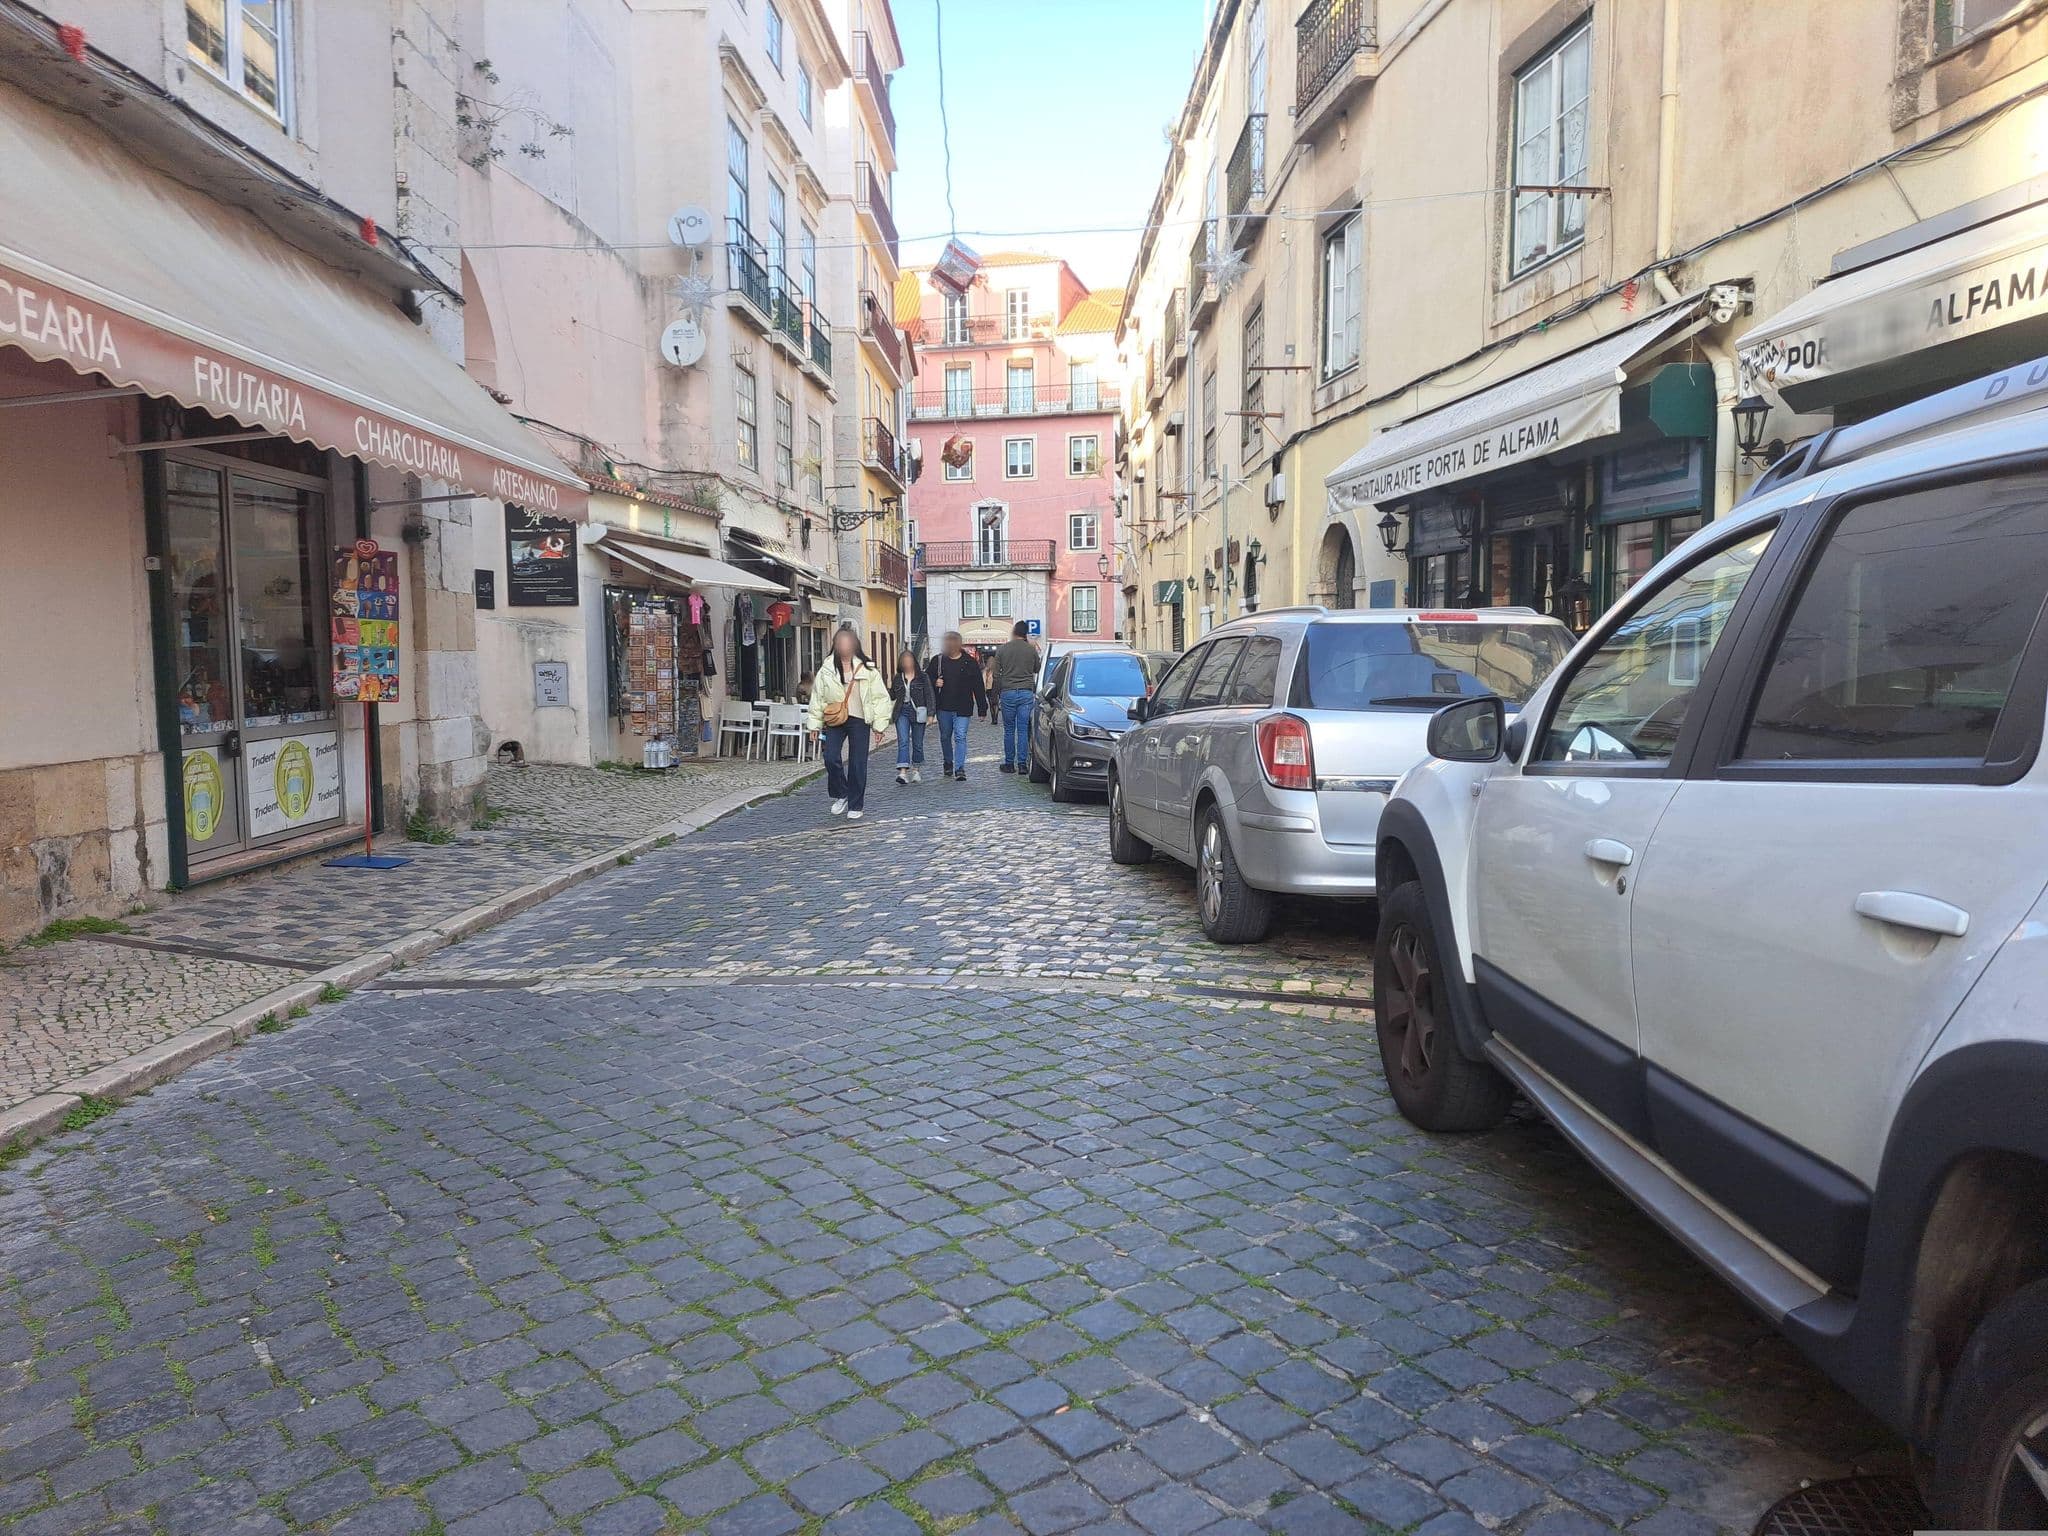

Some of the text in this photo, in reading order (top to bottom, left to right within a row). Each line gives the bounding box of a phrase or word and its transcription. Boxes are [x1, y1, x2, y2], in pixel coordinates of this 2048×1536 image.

[193, 355, 306, 431] FRUTARIA
[354, 415, 463, 482] CHARCUTARIA
[493, 468, 558, 511] ARTESANATO
[1351, 416, 1560, 501] RSTAURANTE PORTA DE ALFAMA
[1028, 621, 1038, 633] P
[251, 751, 276, 768] Trident
[317, 786, 341, 801] Trident
[255, 800, 279, 819] Trident
